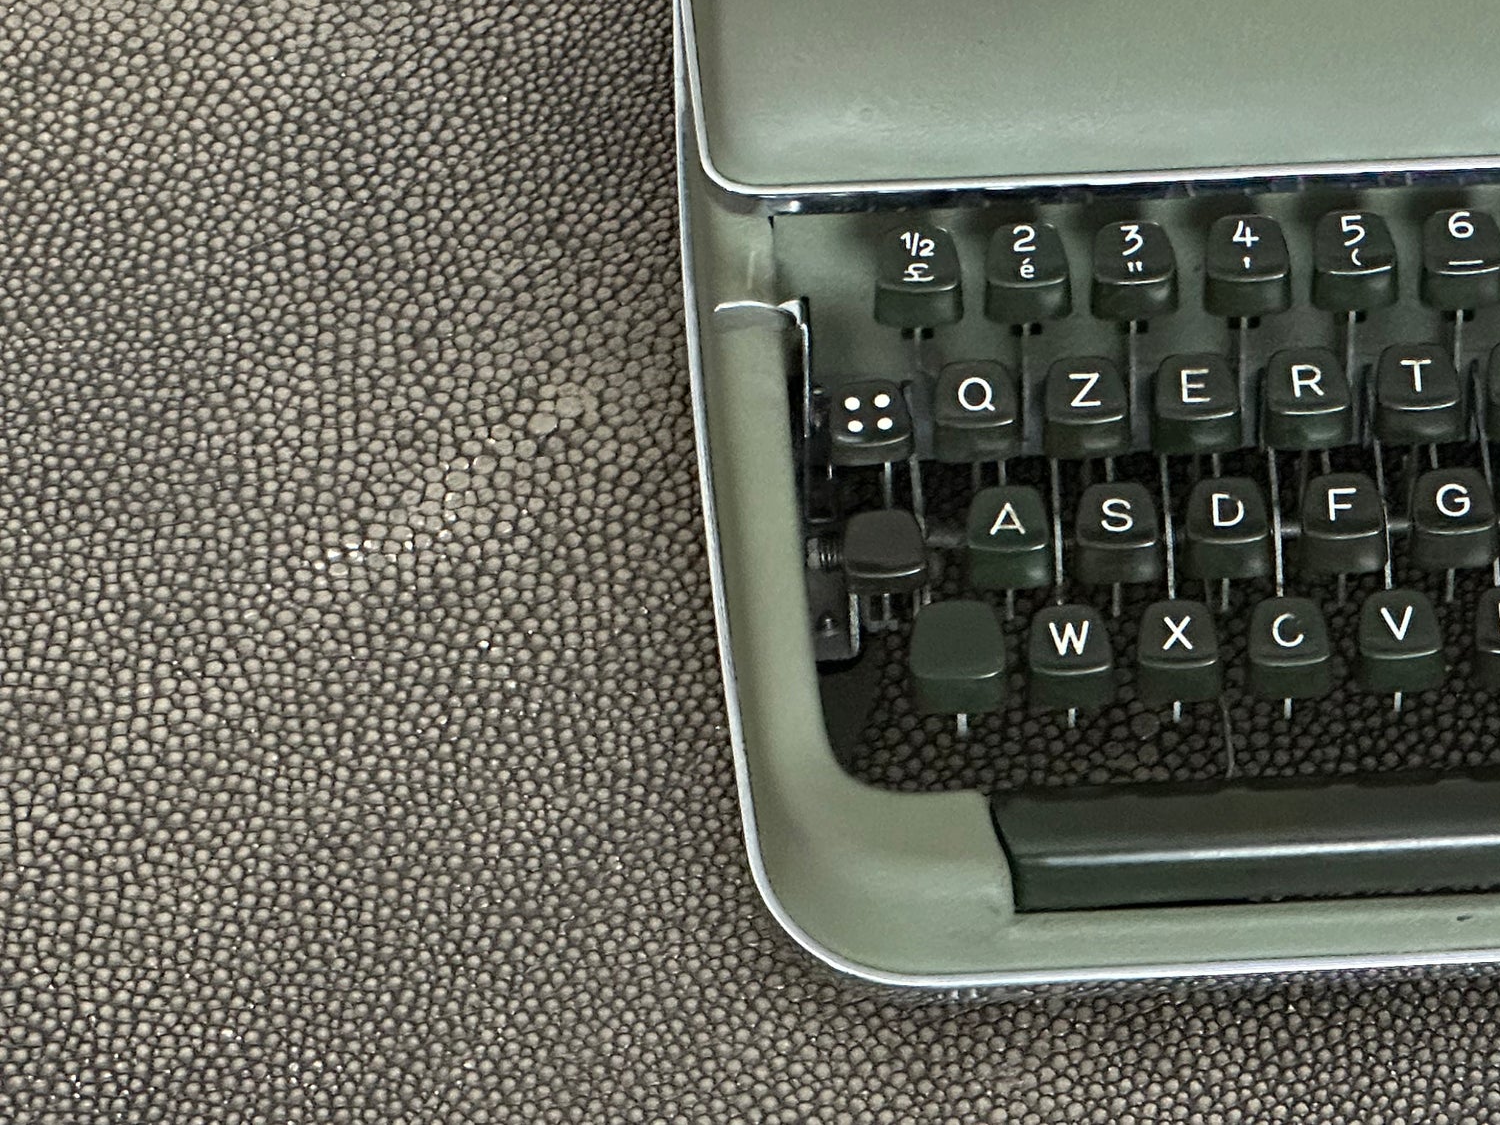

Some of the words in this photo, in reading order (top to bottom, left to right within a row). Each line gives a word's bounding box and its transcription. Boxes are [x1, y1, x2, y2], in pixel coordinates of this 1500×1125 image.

[1012, 224, 1036, 252] 2
[1120, 224, 1144, 256] 3
[1232, 220, 1260, 248] 4
[1340, 214, 1366, 247] 5
[1448, 211, 1475, 239] 6
[1019, 257, 1035, 279] é
[957, 376, 996, 412] Q
[1068, 372, 1102, 407] Z
[1180, 368, 1211, 403] E
[1291, 364, 1325, 398] R
[1399, 359, 1432, 392] T
[989, 502, 1026, 536] A
[1101, 498, 1134, 532] S
[1211, 493, 1245, 527] D
[1327, 487, 1357, 521] F
[1435, 483, 1471, 517] G
[1048, 620, 1090, 656] W
[1162, 615, 1193, 651] X
[1272, 613, 1304, 648] C
[1380, 605, 1413, 641] V
